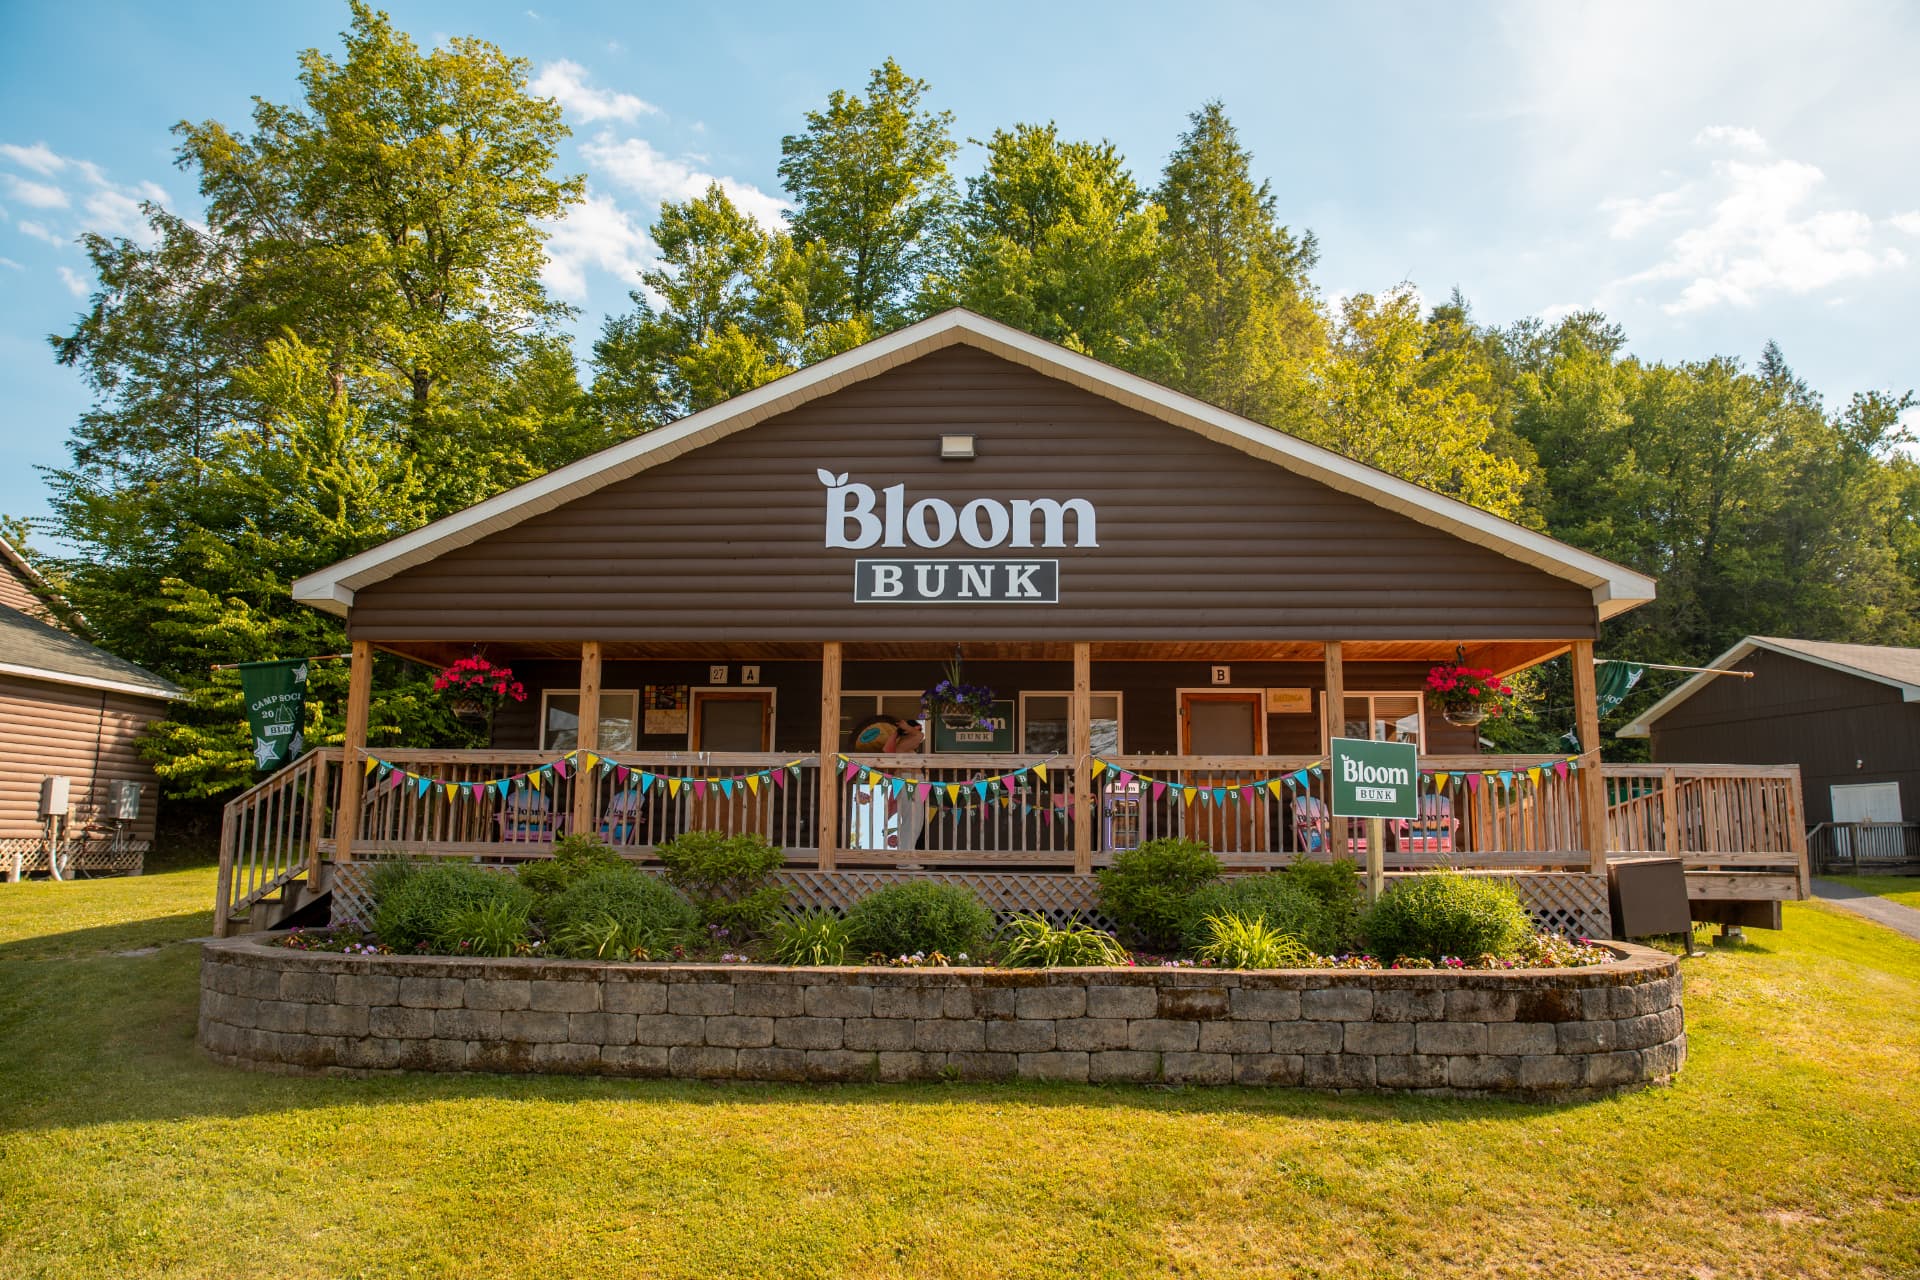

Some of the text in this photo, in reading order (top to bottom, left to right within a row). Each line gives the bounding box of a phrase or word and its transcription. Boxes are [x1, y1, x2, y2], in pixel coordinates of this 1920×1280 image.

[825, 483, 1100, 550] Bloom
[870, 565, 1042, 598] BUNK
[713, 669, 724, 680] 27
[746, 669, 754, 681] A
[1216, 669, 1225, 681] B
[251, 695, 278, 711] CAMP
[261, 710, 274, 719] 20
[1343, 758, 1409, 786] Bloom
[1360, 789, 1392, 800] BUNK
